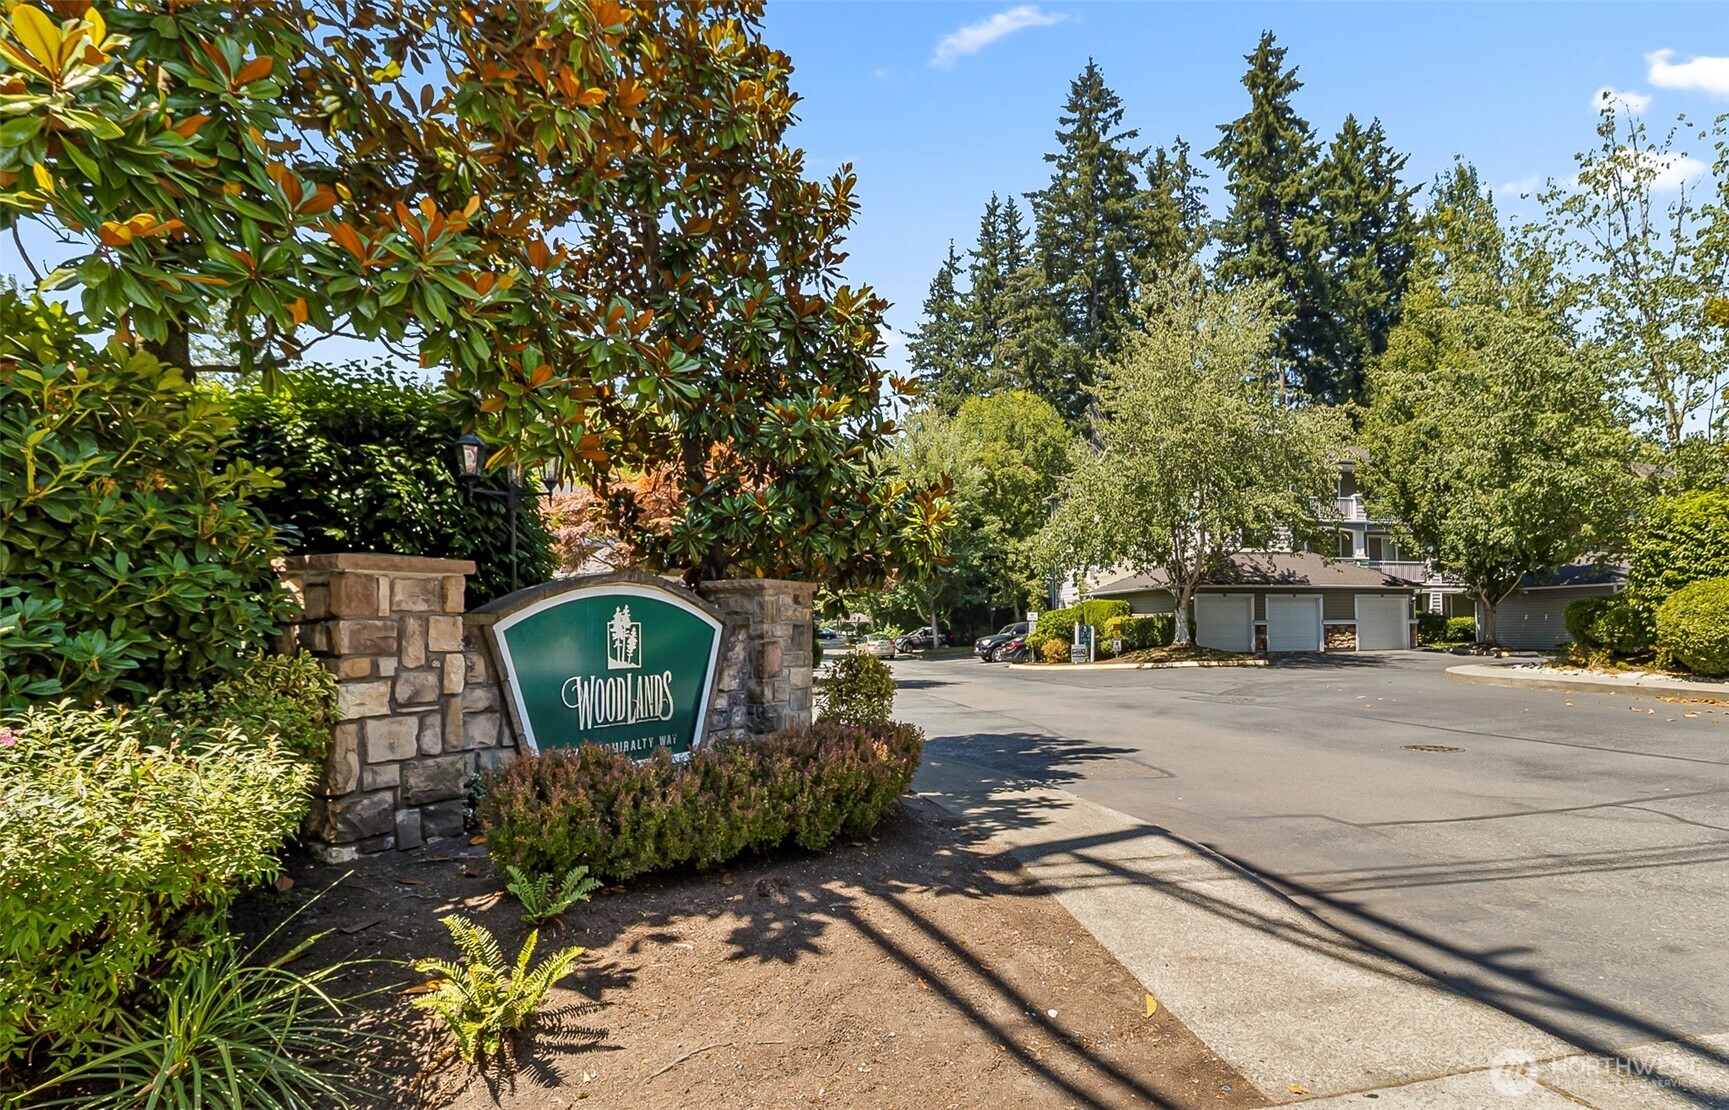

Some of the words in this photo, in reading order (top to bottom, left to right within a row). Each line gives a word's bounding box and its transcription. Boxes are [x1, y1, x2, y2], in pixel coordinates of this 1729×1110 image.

[561, 670, 675, 731] WOODLANDS
[597, 737, 654, 754] DMIRALTY
[659, 733, 678, 746] WAY
